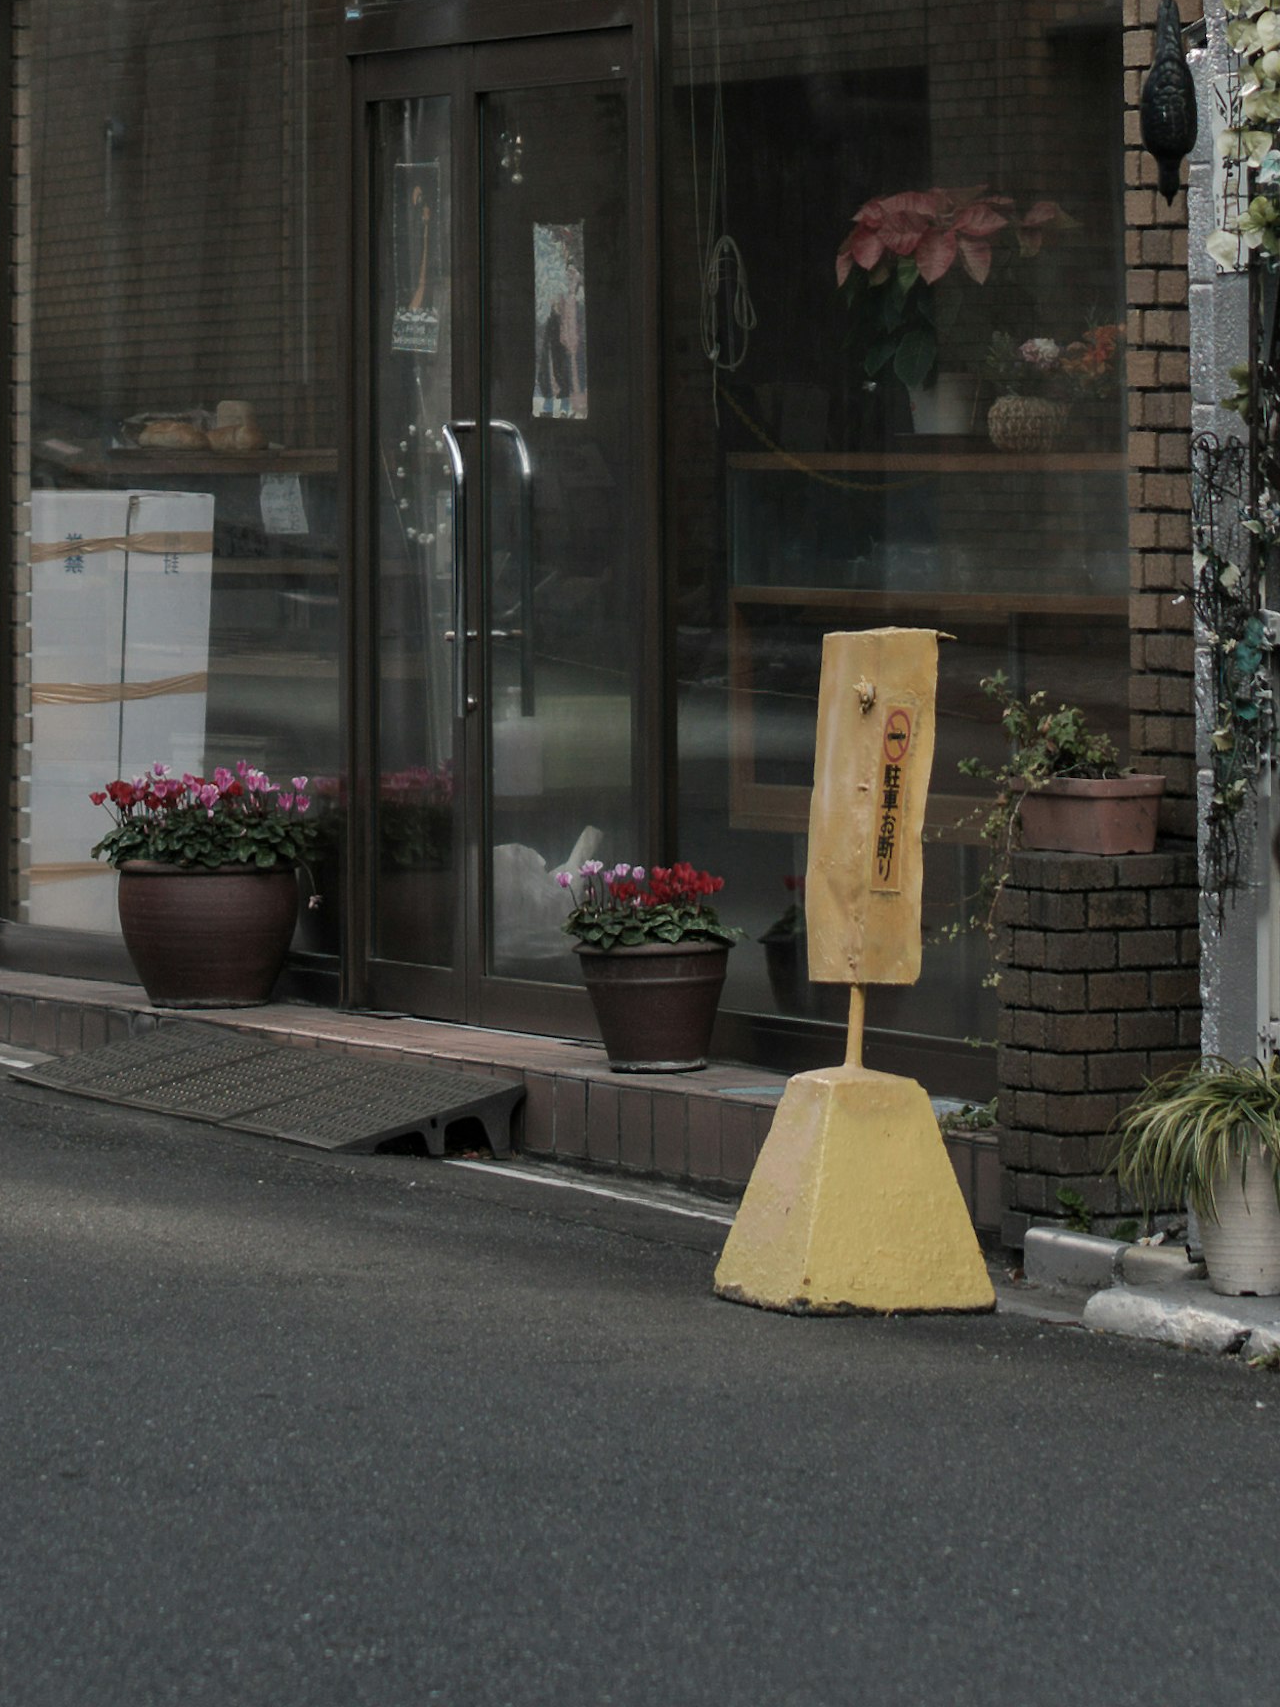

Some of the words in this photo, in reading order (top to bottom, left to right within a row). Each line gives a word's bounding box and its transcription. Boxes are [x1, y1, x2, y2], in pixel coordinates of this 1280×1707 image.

[876, 763, 902, 882] 駐車お断り
